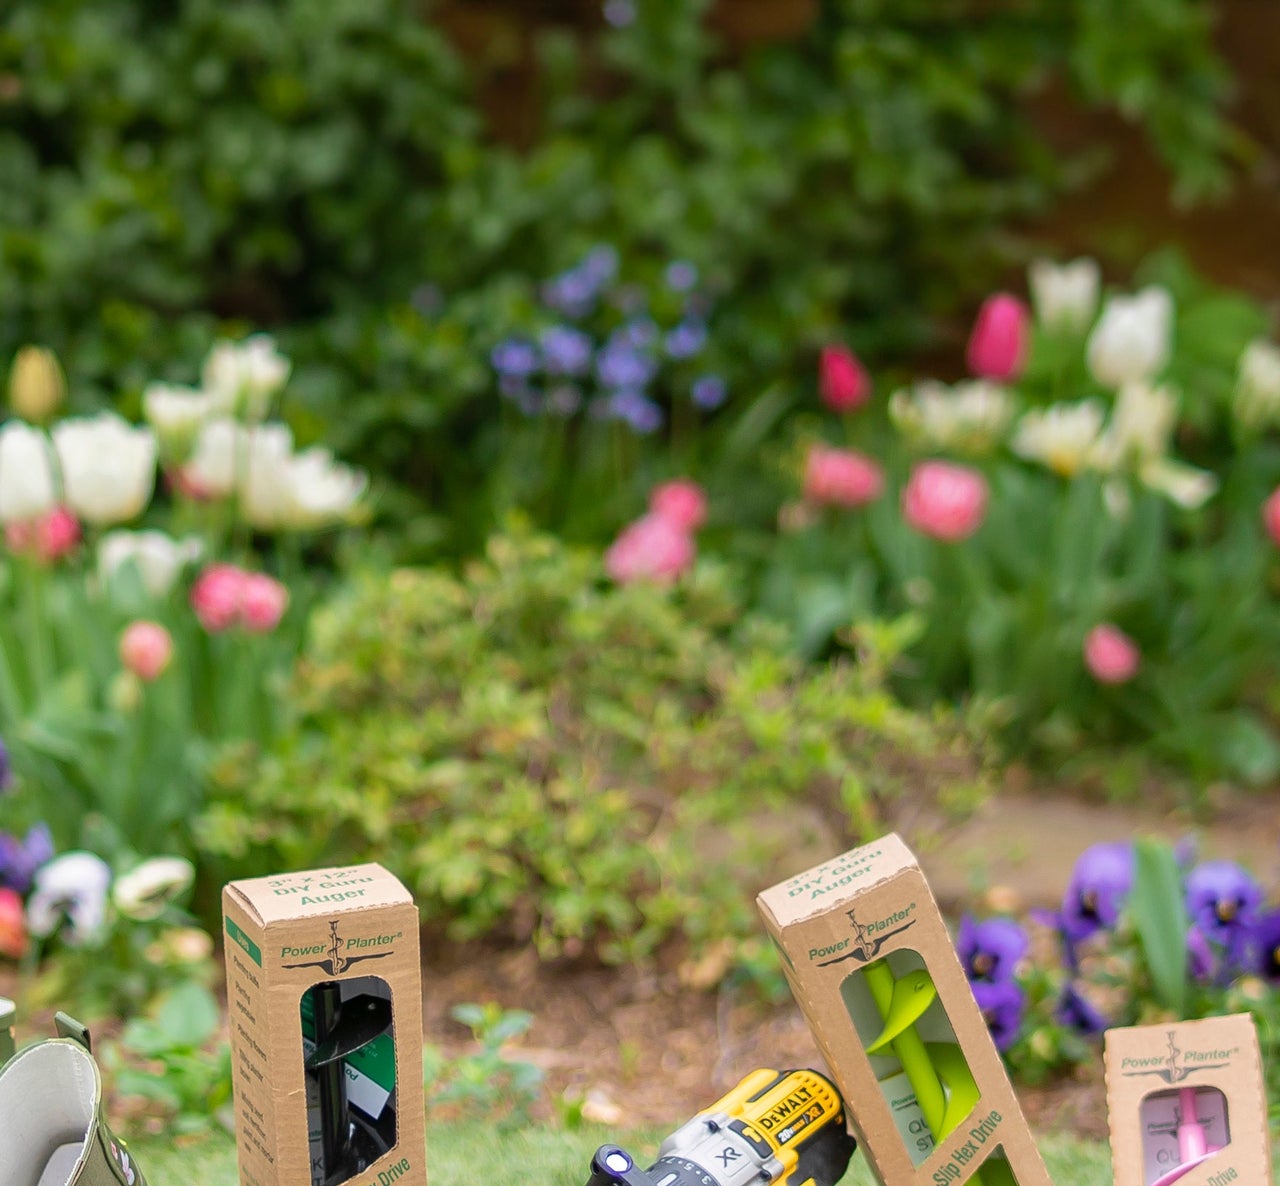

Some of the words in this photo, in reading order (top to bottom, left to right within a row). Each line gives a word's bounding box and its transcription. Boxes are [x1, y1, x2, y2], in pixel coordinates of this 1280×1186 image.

[788, 877, 823, 898] DIY
[831, 850, 883, 876] Guru
[811, 865, 873, 900] Auger
[273, 885, 310, 896] DIY
[319, 876, 374, 890] Guru
[300, 887, 366, 906] Auger
[280, 943, 327, 958] Power
[809, 937, 850, 961] Power
[1122, 1056, 1165, 1069] Power
[759, 1086, 813, 1130] DEWALT
[951, 1140, 980, 1167] Hex
[969, 1109, 1003, 1144] Drive
[714, 1147, 743, 1168] XR
